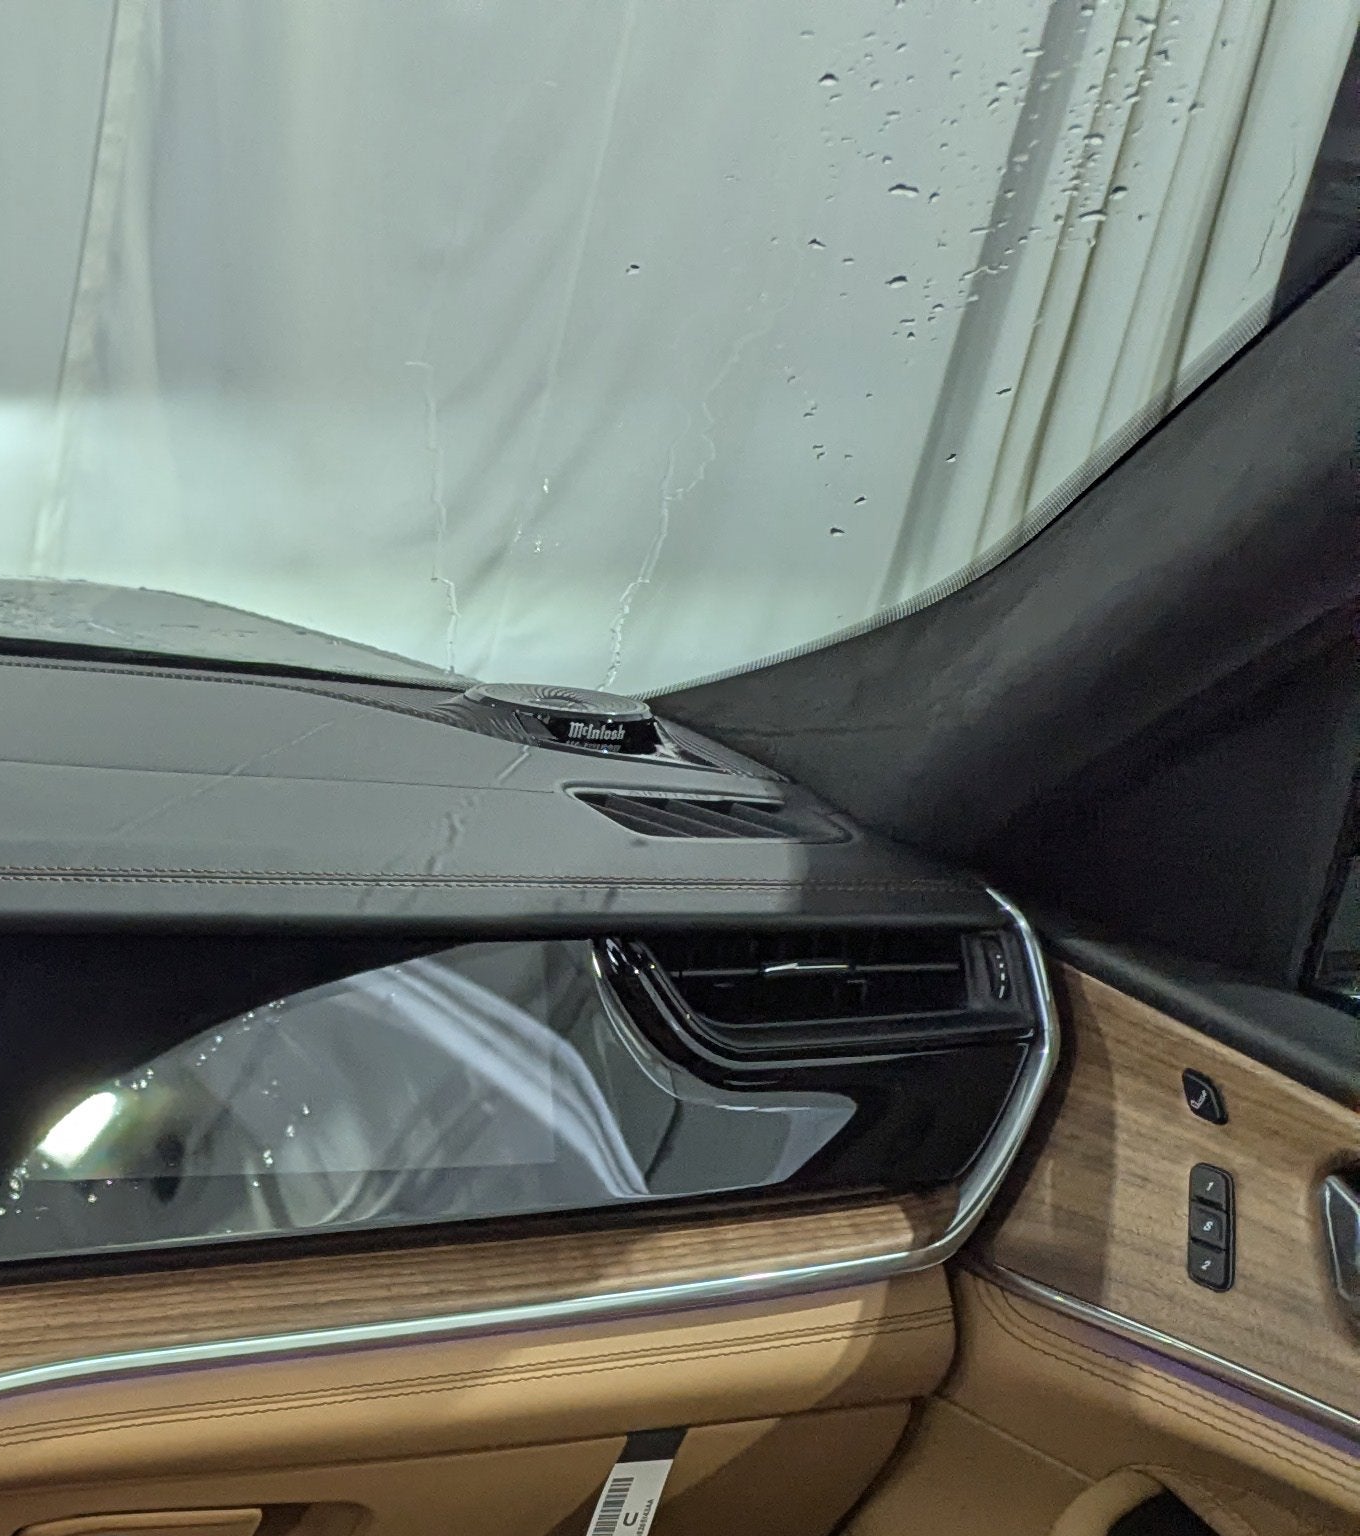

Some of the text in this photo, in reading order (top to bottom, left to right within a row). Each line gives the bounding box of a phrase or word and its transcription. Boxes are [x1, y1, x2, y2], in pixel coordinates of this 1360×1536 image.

[568, 721, 626, 740] McIntosh
[1206, 1181, 1214, 1192] 1
[1200, 1259, 1211, 1270] 2
[623, 1512, 639, 1527] U
